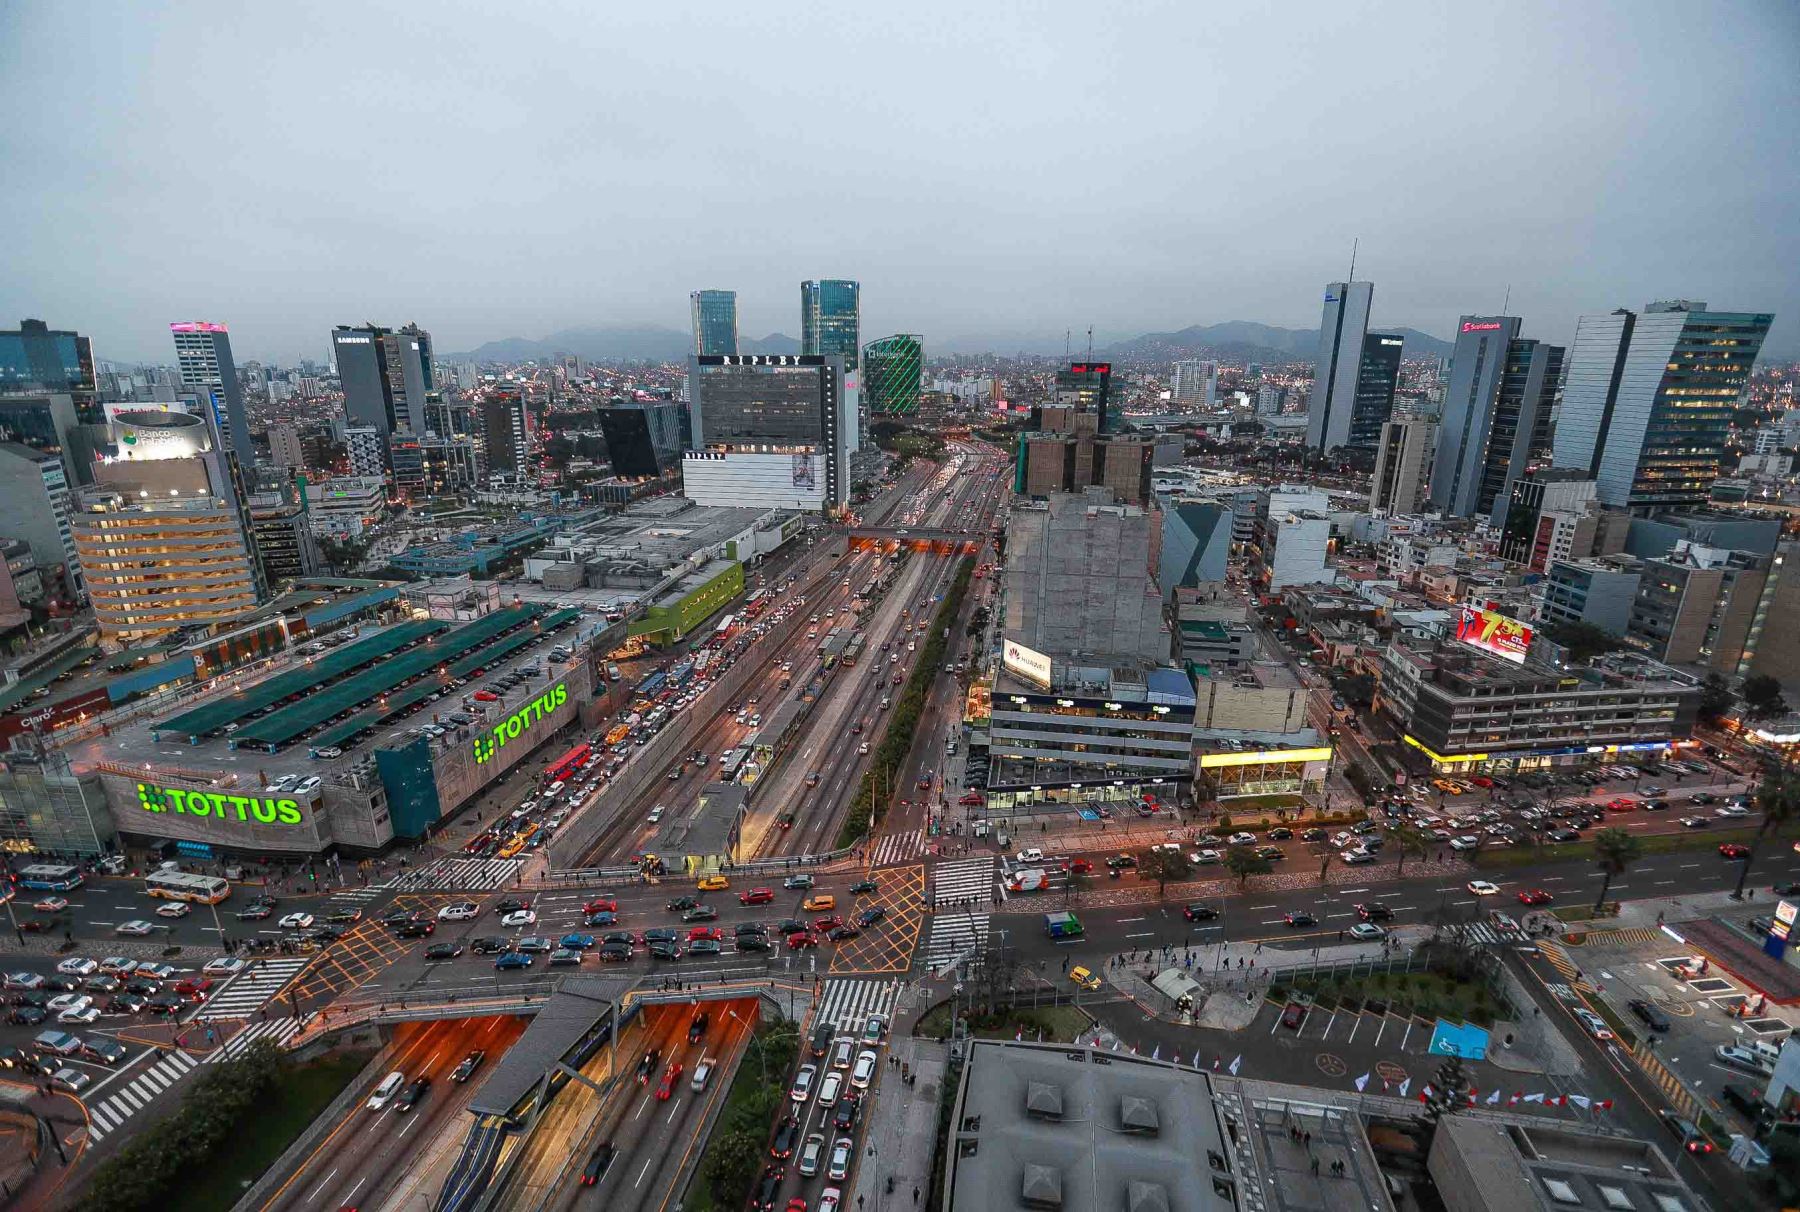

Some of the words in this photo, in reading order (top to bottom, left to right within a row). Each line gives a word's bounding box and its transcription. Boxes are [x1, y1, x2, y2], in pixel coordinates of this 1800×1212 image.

[723, 355, 801, 366] RIPLEY
[139, 429, 170, 438] Banco
[685, 452, 723, 460] RIPLEY
[21, 712, 51, 727] Claro
[493, 684, 567, 747] TOTTUS
[165, 789, 302, 823] TOTTUS
